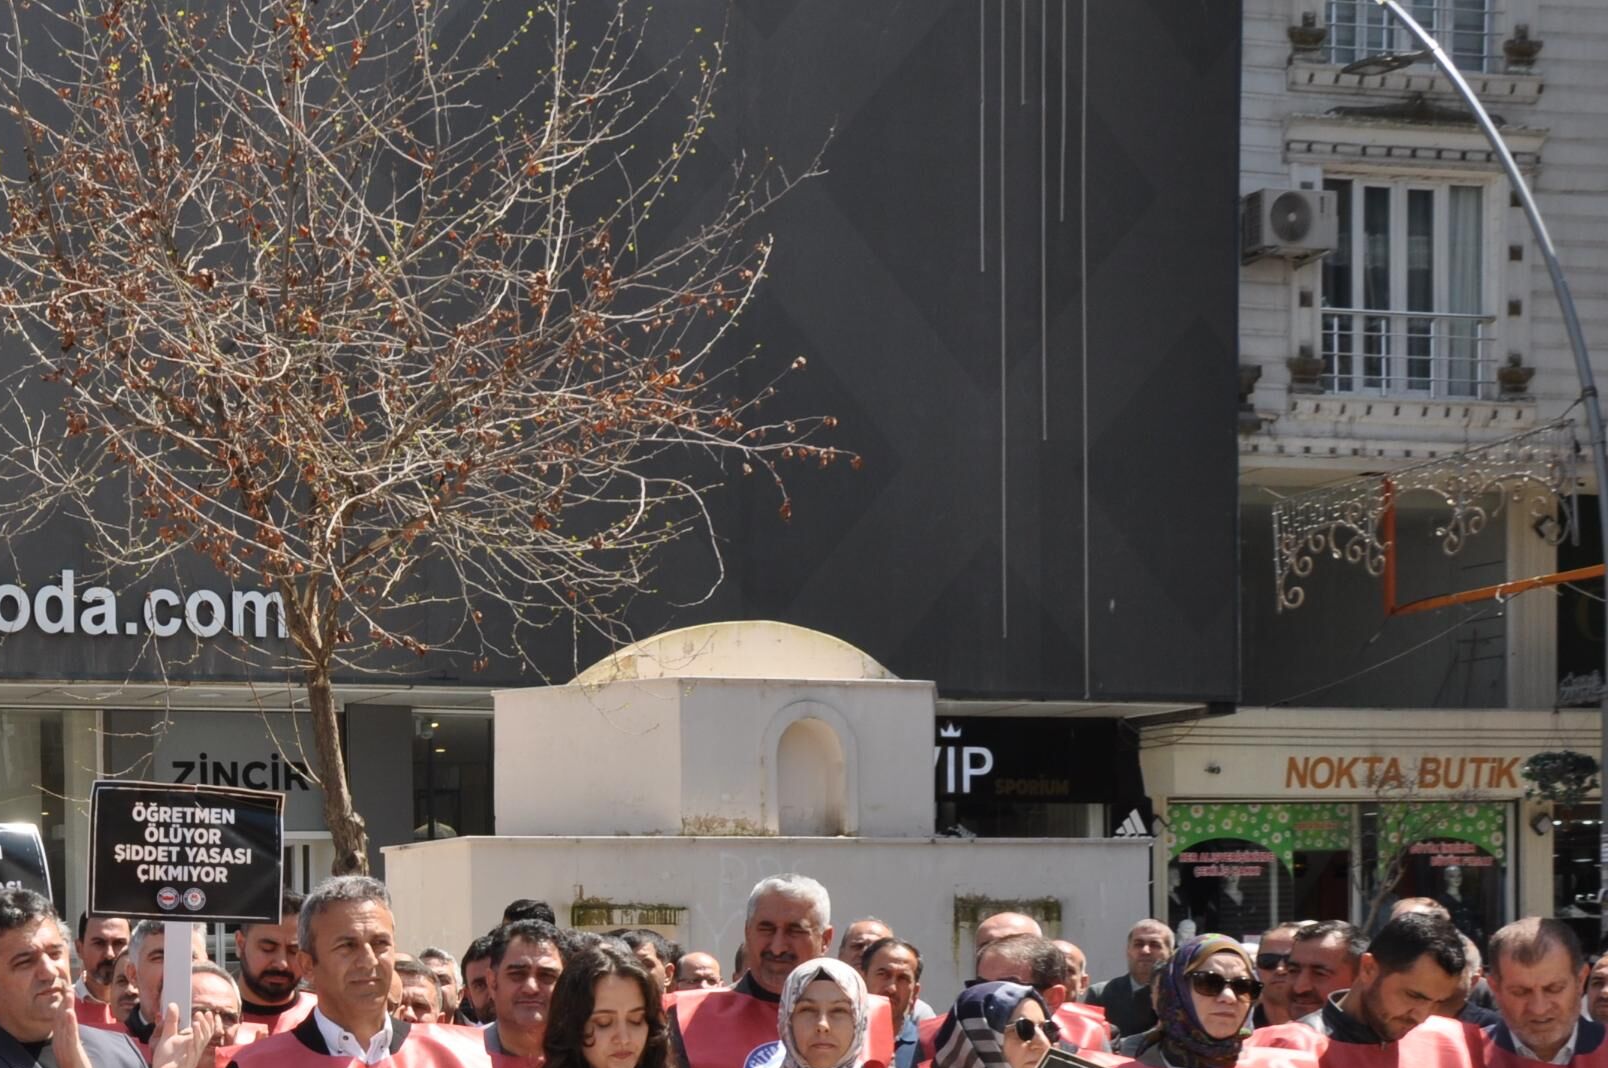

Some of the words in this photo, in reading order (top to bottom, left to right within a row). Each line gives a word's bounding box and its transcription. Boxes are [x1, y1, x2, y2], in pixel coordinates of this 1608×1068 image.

[172, 752, 310, 791] ZİNCİR
[1285, 756, 1404, 789] NOKTA
[1417, 756, 1522, 789] BUTİK
[132, 802, 235, 825] ÖĞRETMEN
[144, 824, 222, 845] ÖLÜYOR
[114, 844, 180, 863] ŞİDDET
[185, 848, 252, 865] YASASI
[136, 864, 228, 883] ÇIKMIYOR
